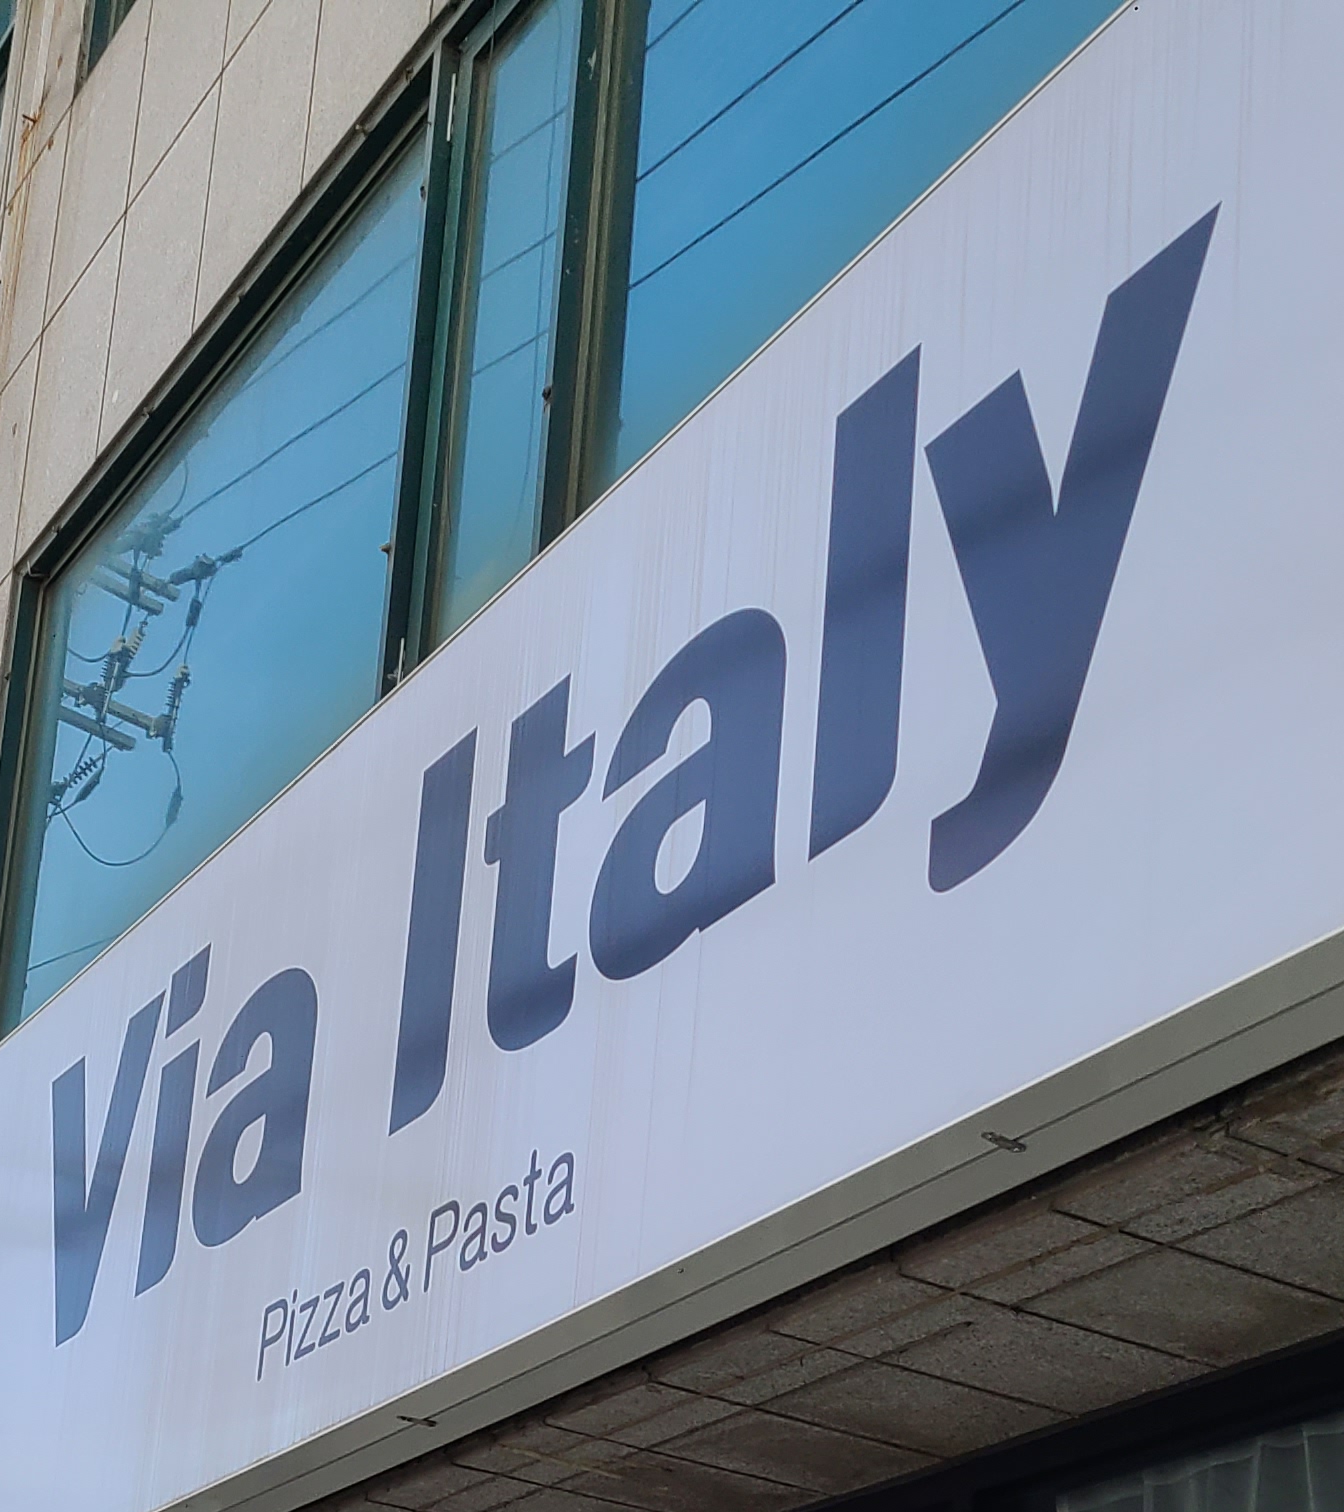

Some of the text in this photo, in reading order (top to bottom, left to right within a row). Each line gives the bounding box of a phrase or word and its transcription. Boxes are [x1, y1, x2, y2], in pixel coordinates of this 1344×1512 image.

[51, 200, 1223, 1348] Via Italy
[256, 1149, 576, 1382] Pizza & Pasta
